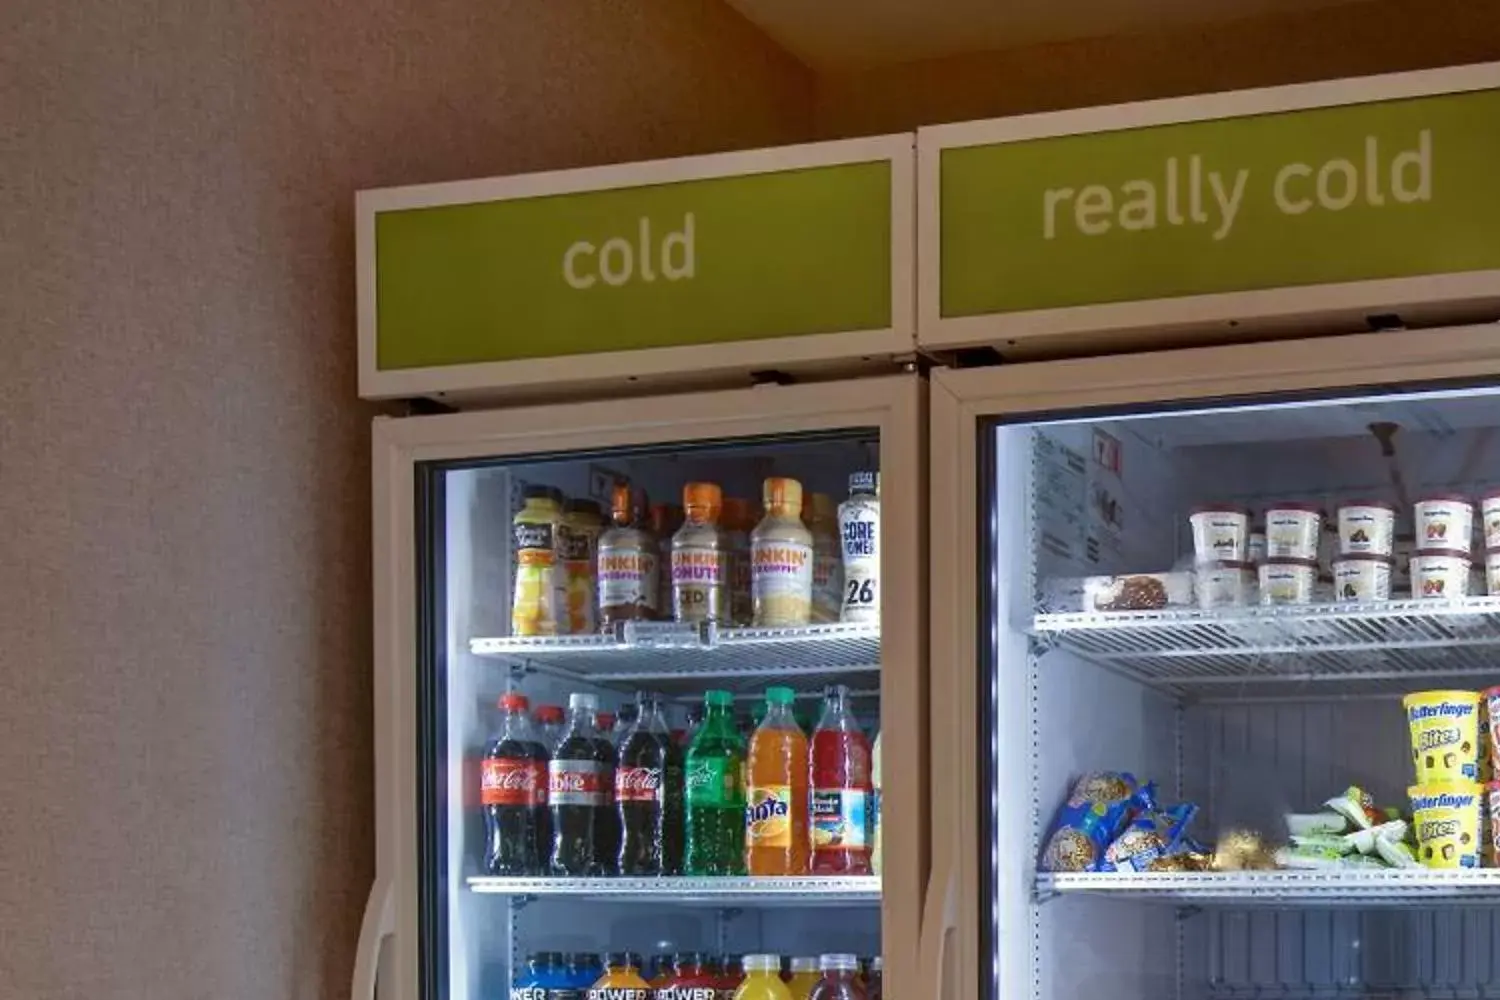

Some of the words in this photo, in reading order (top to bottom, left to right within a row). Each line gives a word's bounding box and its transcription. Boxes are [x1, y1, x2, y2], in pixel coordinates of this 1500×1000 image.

[1041, 151, 1248, 243] really
[1272, 130, 1436, 217] cold
[561, 212, 695, 291] cold
[745, 797, 789, 825] anta
